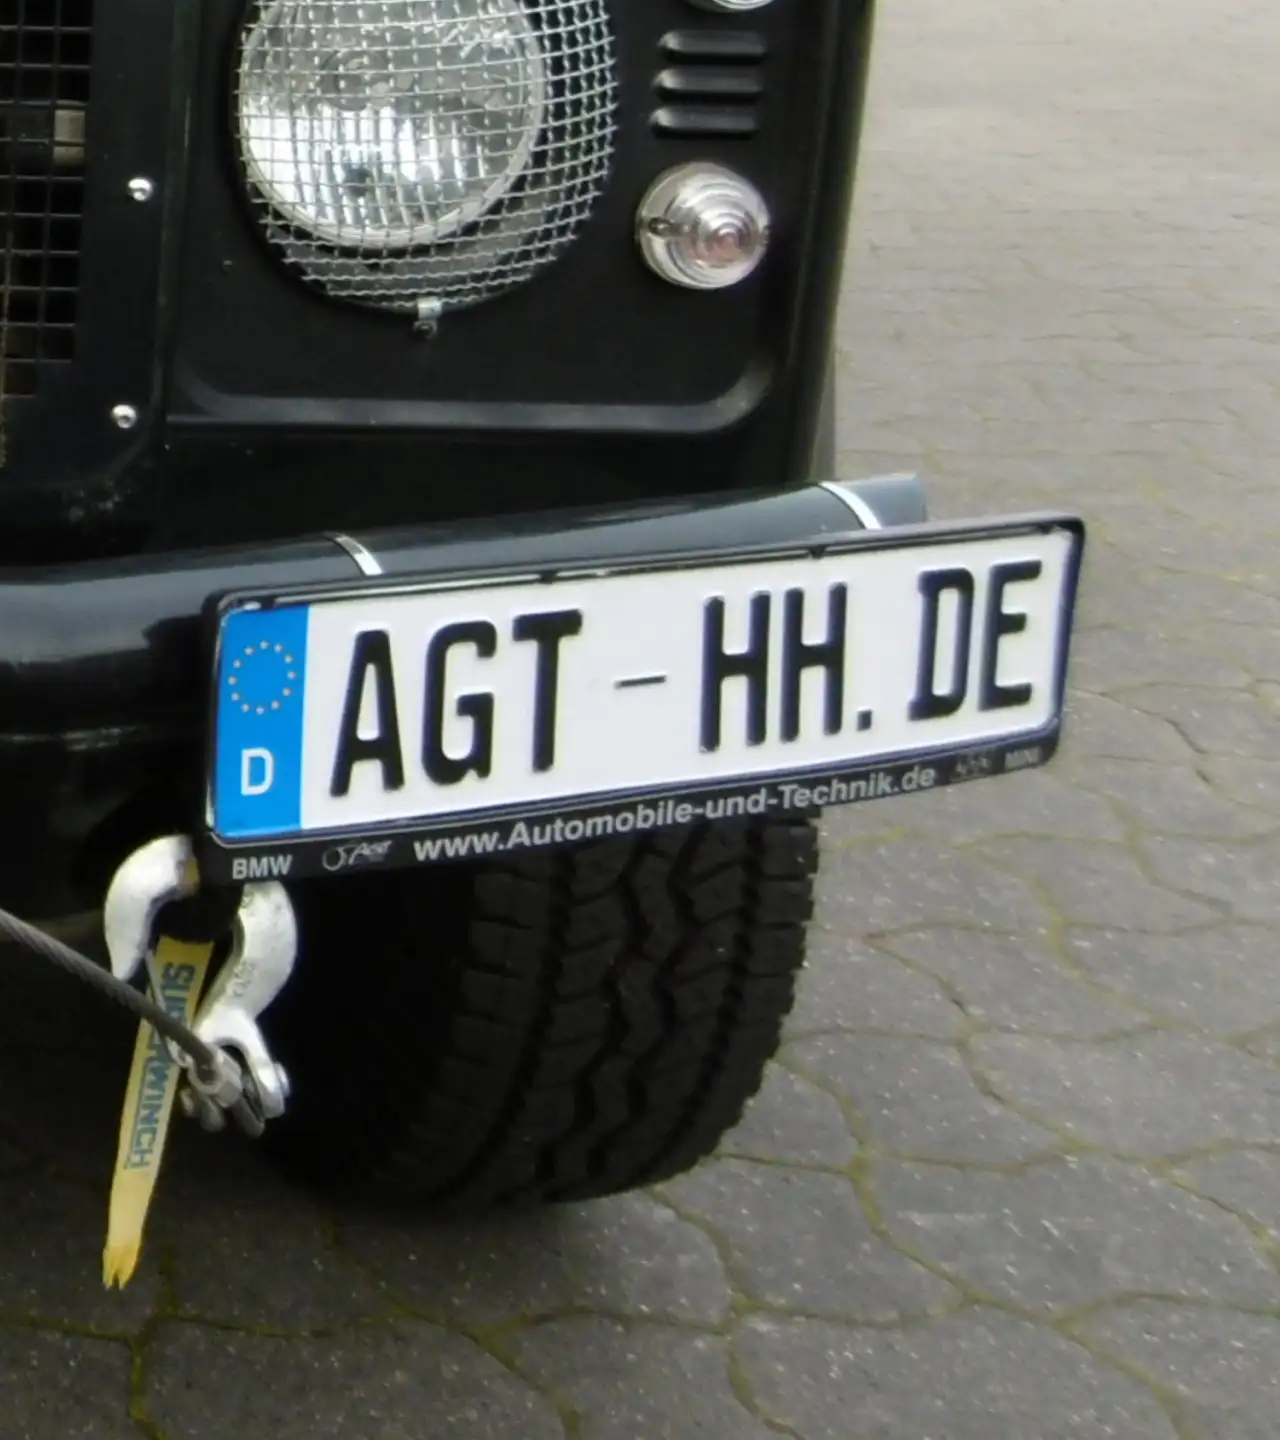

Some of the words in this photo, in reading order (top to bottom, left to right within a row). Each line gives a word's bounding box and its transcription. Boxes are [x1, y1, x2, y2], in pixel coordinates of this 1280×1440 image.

[330, 607, 583, 799] AGT
[240, 747, 275, 797] D
[413, 764, 937, 864] www.Automobile-und-Technik.de
[231, 854, 293, 881] BMW
